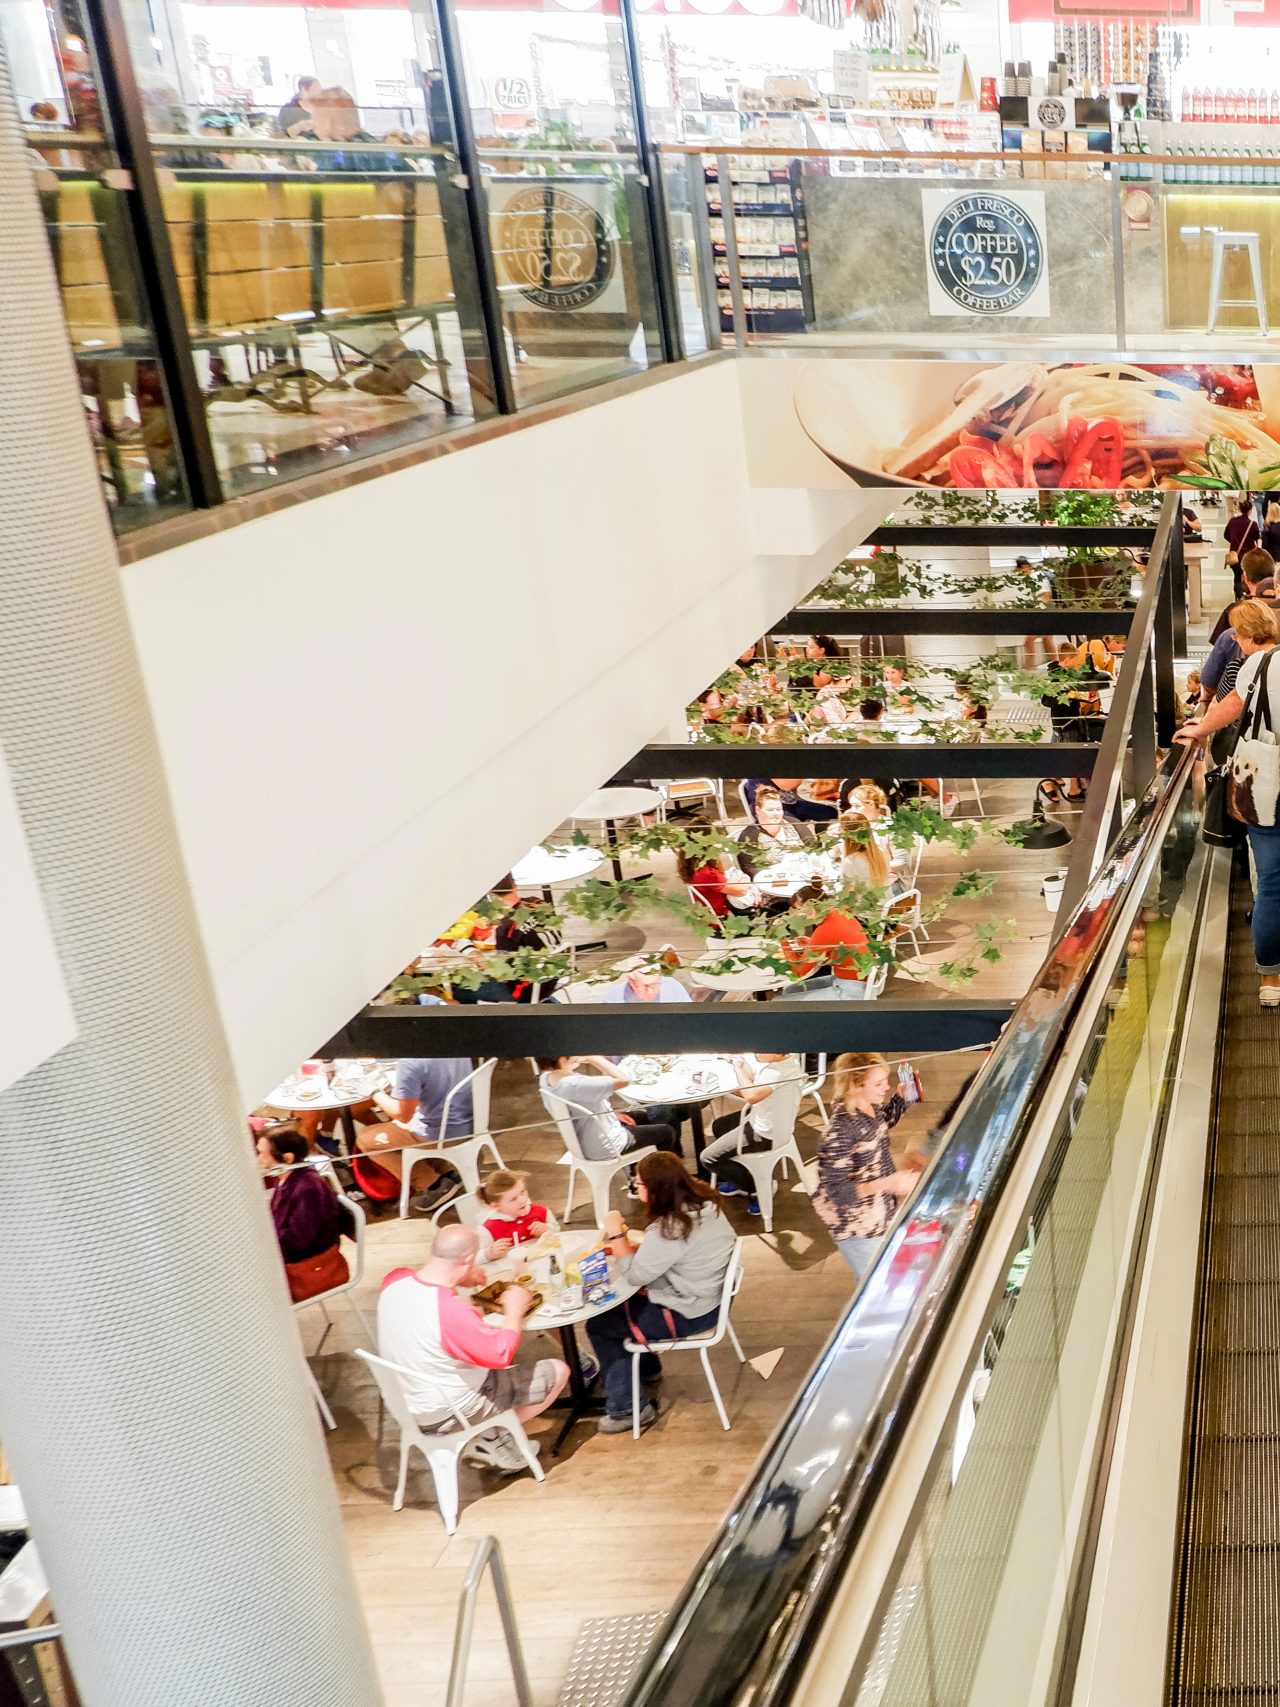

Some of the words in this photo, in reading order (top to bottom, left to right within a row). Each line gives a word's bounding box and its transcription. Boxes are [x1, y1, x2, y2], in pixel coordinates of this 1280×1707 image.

[500, 78, 526, 95] 1/2
[500, 94, 528, 105] PRICE
[945, 199, 974, 224] DELI
[977, 198, 1025, 227] FRESCO
[951, 232, 1019, 254] COFFEE
[960, 256, 1016, 287] $2.50
[952, 286, 1000, 310] COFFEE
[1000, 287, 1025, 309] BAR
